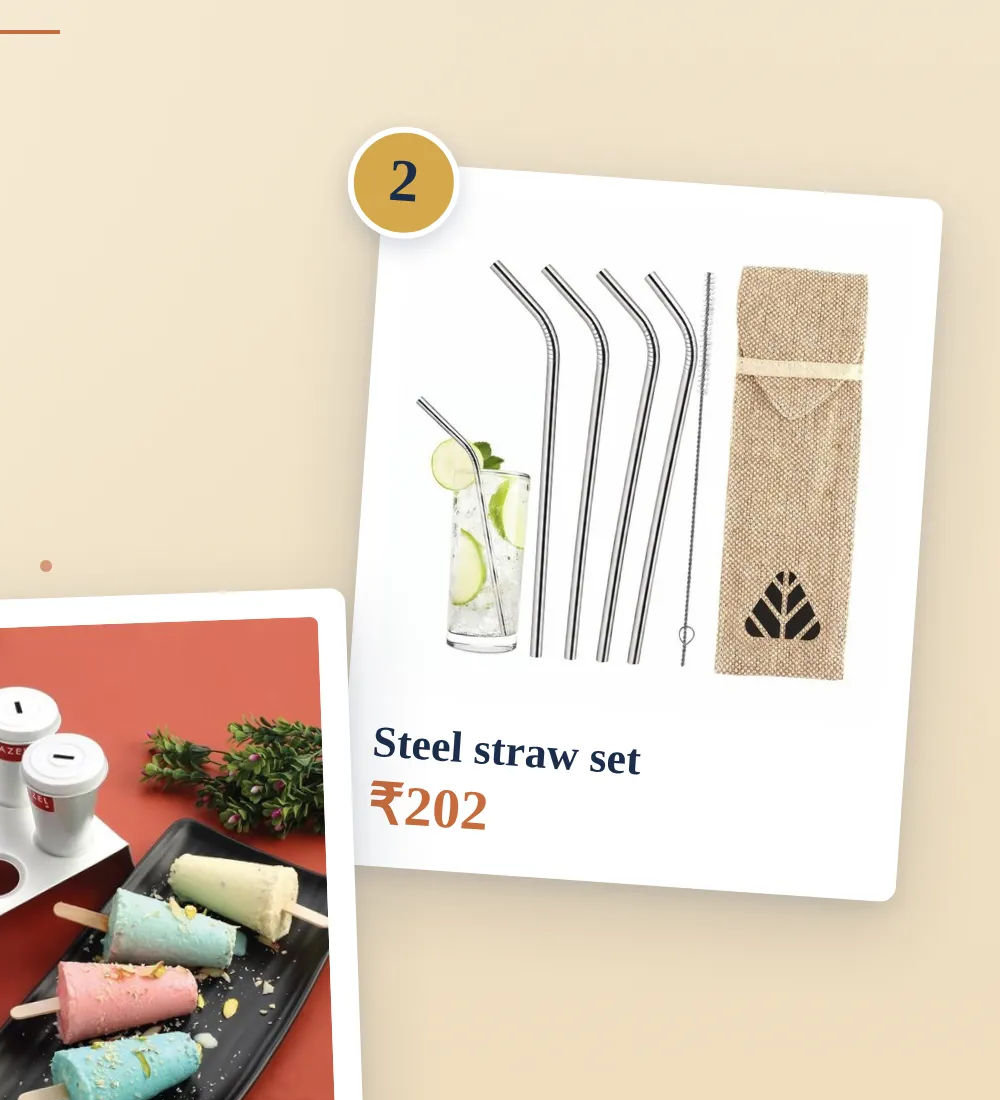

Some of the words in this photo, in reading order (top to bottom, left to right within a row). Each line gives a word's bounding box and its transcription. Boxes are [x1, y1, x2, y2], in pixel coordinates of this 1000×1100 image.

[389, 160, 417, 202] 2
[373, 726, 462, 763] Steel
[474, 739, 580, 771] straw
[589, 748, 641, 776] set
[370, 779, 487, 831] ₹202
